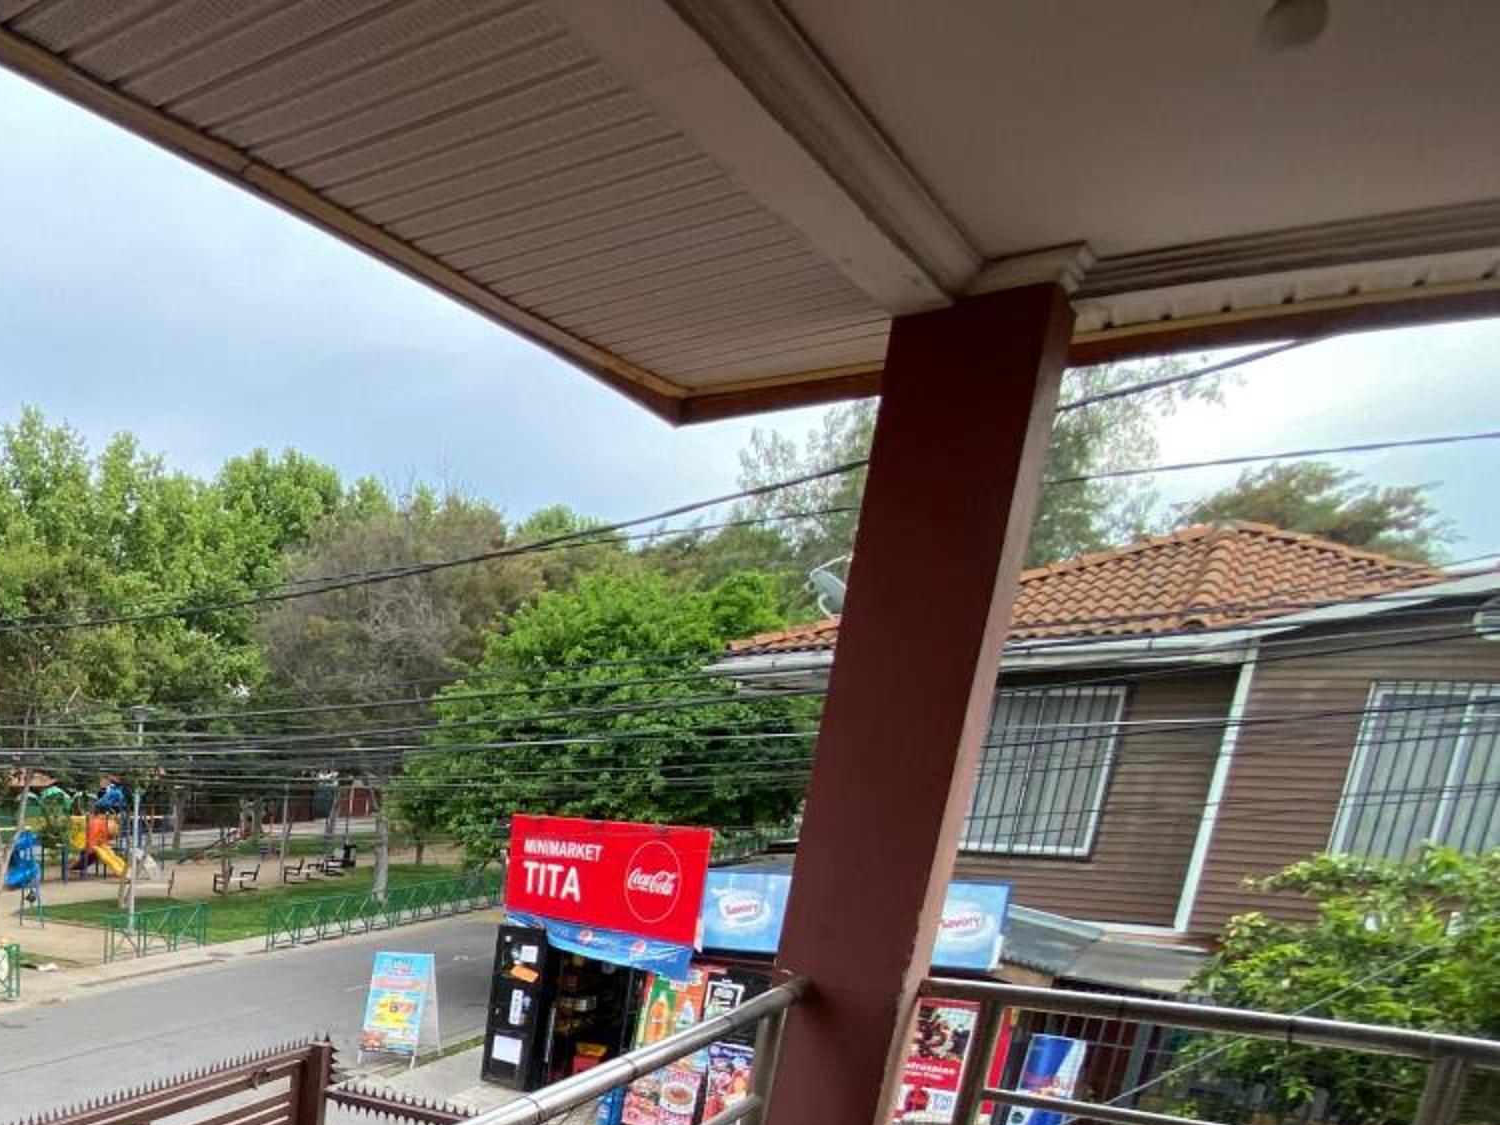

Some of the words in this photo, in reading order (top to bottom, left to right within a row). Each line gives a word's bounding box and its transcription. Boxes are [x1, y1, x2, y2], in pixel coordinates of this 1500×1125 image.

[523, 838, 605, 863] MINIMARKET
[523, 861, 581, 903] TITA
[627, 867, 678, 896] Coca-Cola
[725, 902, 758, 916] Savory
